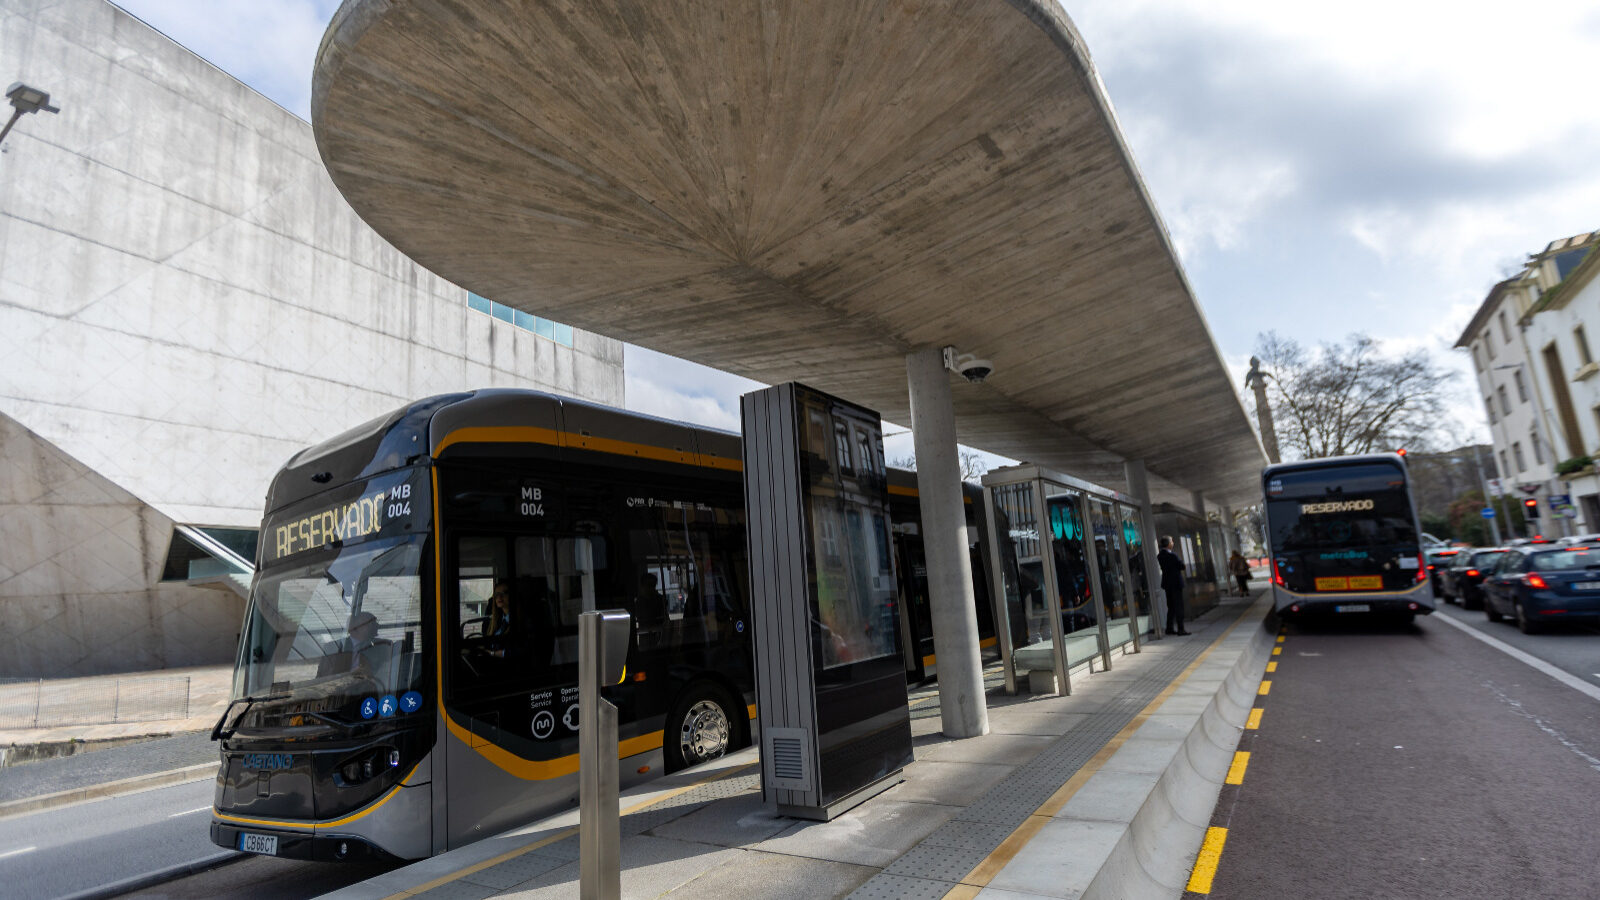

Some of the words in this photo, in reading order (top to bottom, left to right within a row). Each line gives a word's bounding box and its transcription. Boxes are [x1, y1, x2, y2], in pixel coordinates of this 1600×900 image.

[391, 484, 411, 500] MB
[521, 487, 542, 500] MB
[388, 501, 411, 518] 004
[521, 503, 544, 517] 004
[1302, 499, 1373, 514] RESERVADO
[531, 692, 552, 700] Serviço
[531, 700, 551, 708] Service
[242, 753, 293, 769] CAETANO
[247, 836, 274, 853] CB66CT
